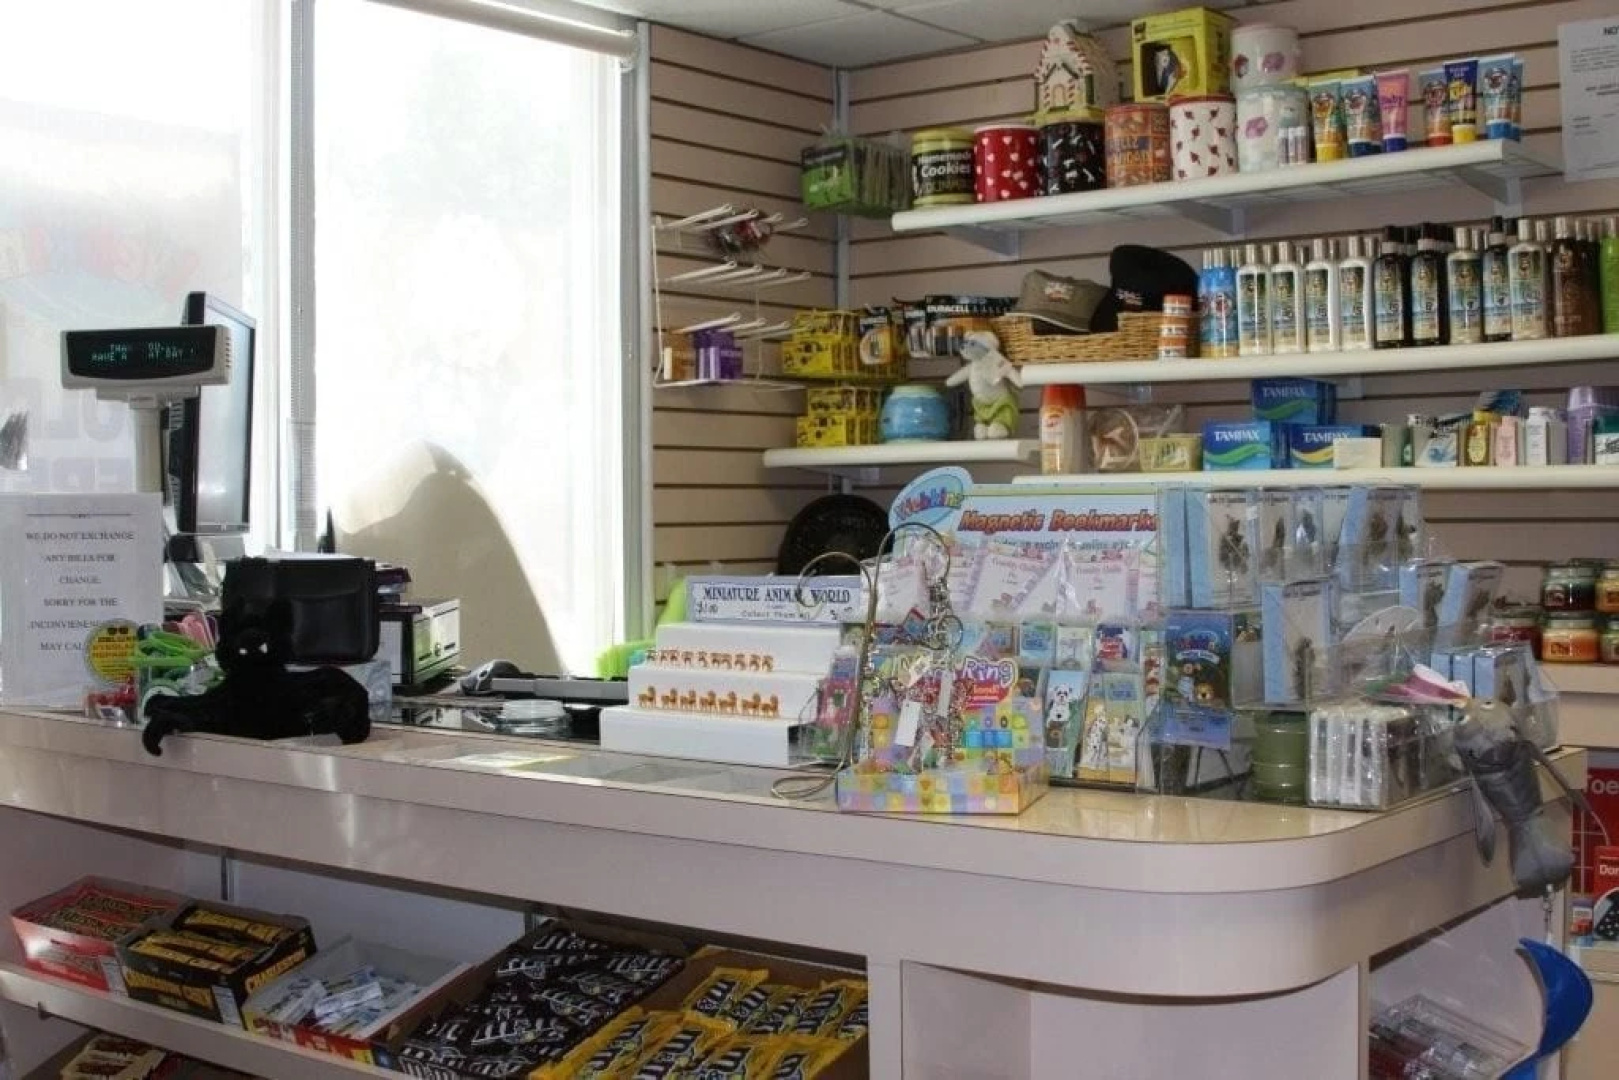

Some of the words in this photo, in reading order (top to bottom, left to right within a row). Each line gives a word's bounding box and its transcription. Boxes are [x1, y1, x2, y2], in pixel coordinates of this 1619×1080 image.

[1262, 386, 1306, 398] TAMPAX
[1214, 430, 1260, 442] TAMPAX
[957, 508, 1046, 535] Magnetic
[704, 587, 760, 601] MINIATURE
[100, 598, 118, 607] THE
[962, 656, 1014, 690] Ring
